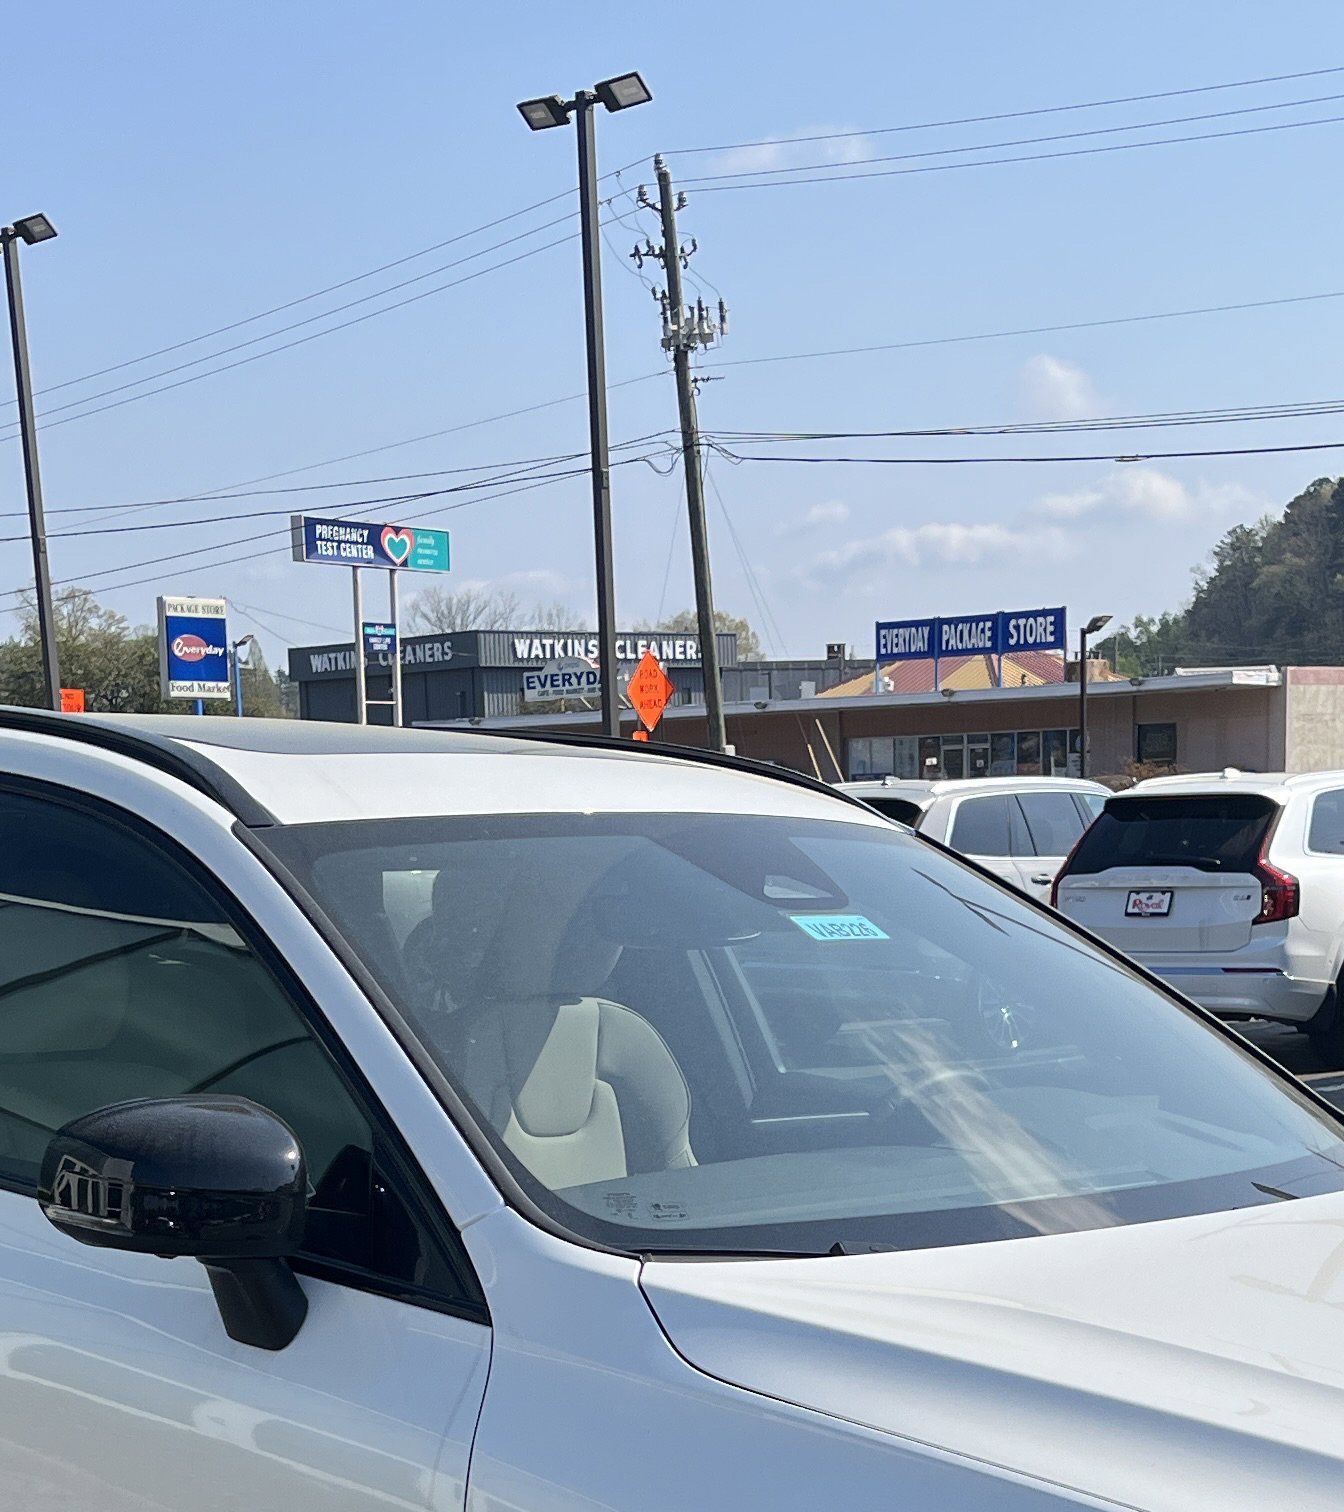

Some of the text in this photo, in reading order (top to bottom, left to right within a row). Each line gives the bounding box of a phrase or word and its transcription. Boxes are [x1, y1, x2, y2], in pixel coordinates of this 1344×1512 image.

[315, 524, 369, 542] PREGNANCY
[316, 541, 375, 559] TEST CENTER
[167, 603, 224, 615] PACKAGE STORE
[880, 615, 1055, 654] EVERYDAY PACKAGE STORE
[514, 639, 702, 660] WATKINS CLEANER
[310, 650, 368, 673] WATKIN
[526, 671, 599, 690] EVERYD
[640, 669, 657, 679] ROAD
[171, 683, 231, 694] Food Market
[640, 685, 658, 693] WORK
[640, 699, 662, 709] AHEAD
[1131, 898, 1165, 912] Royal
